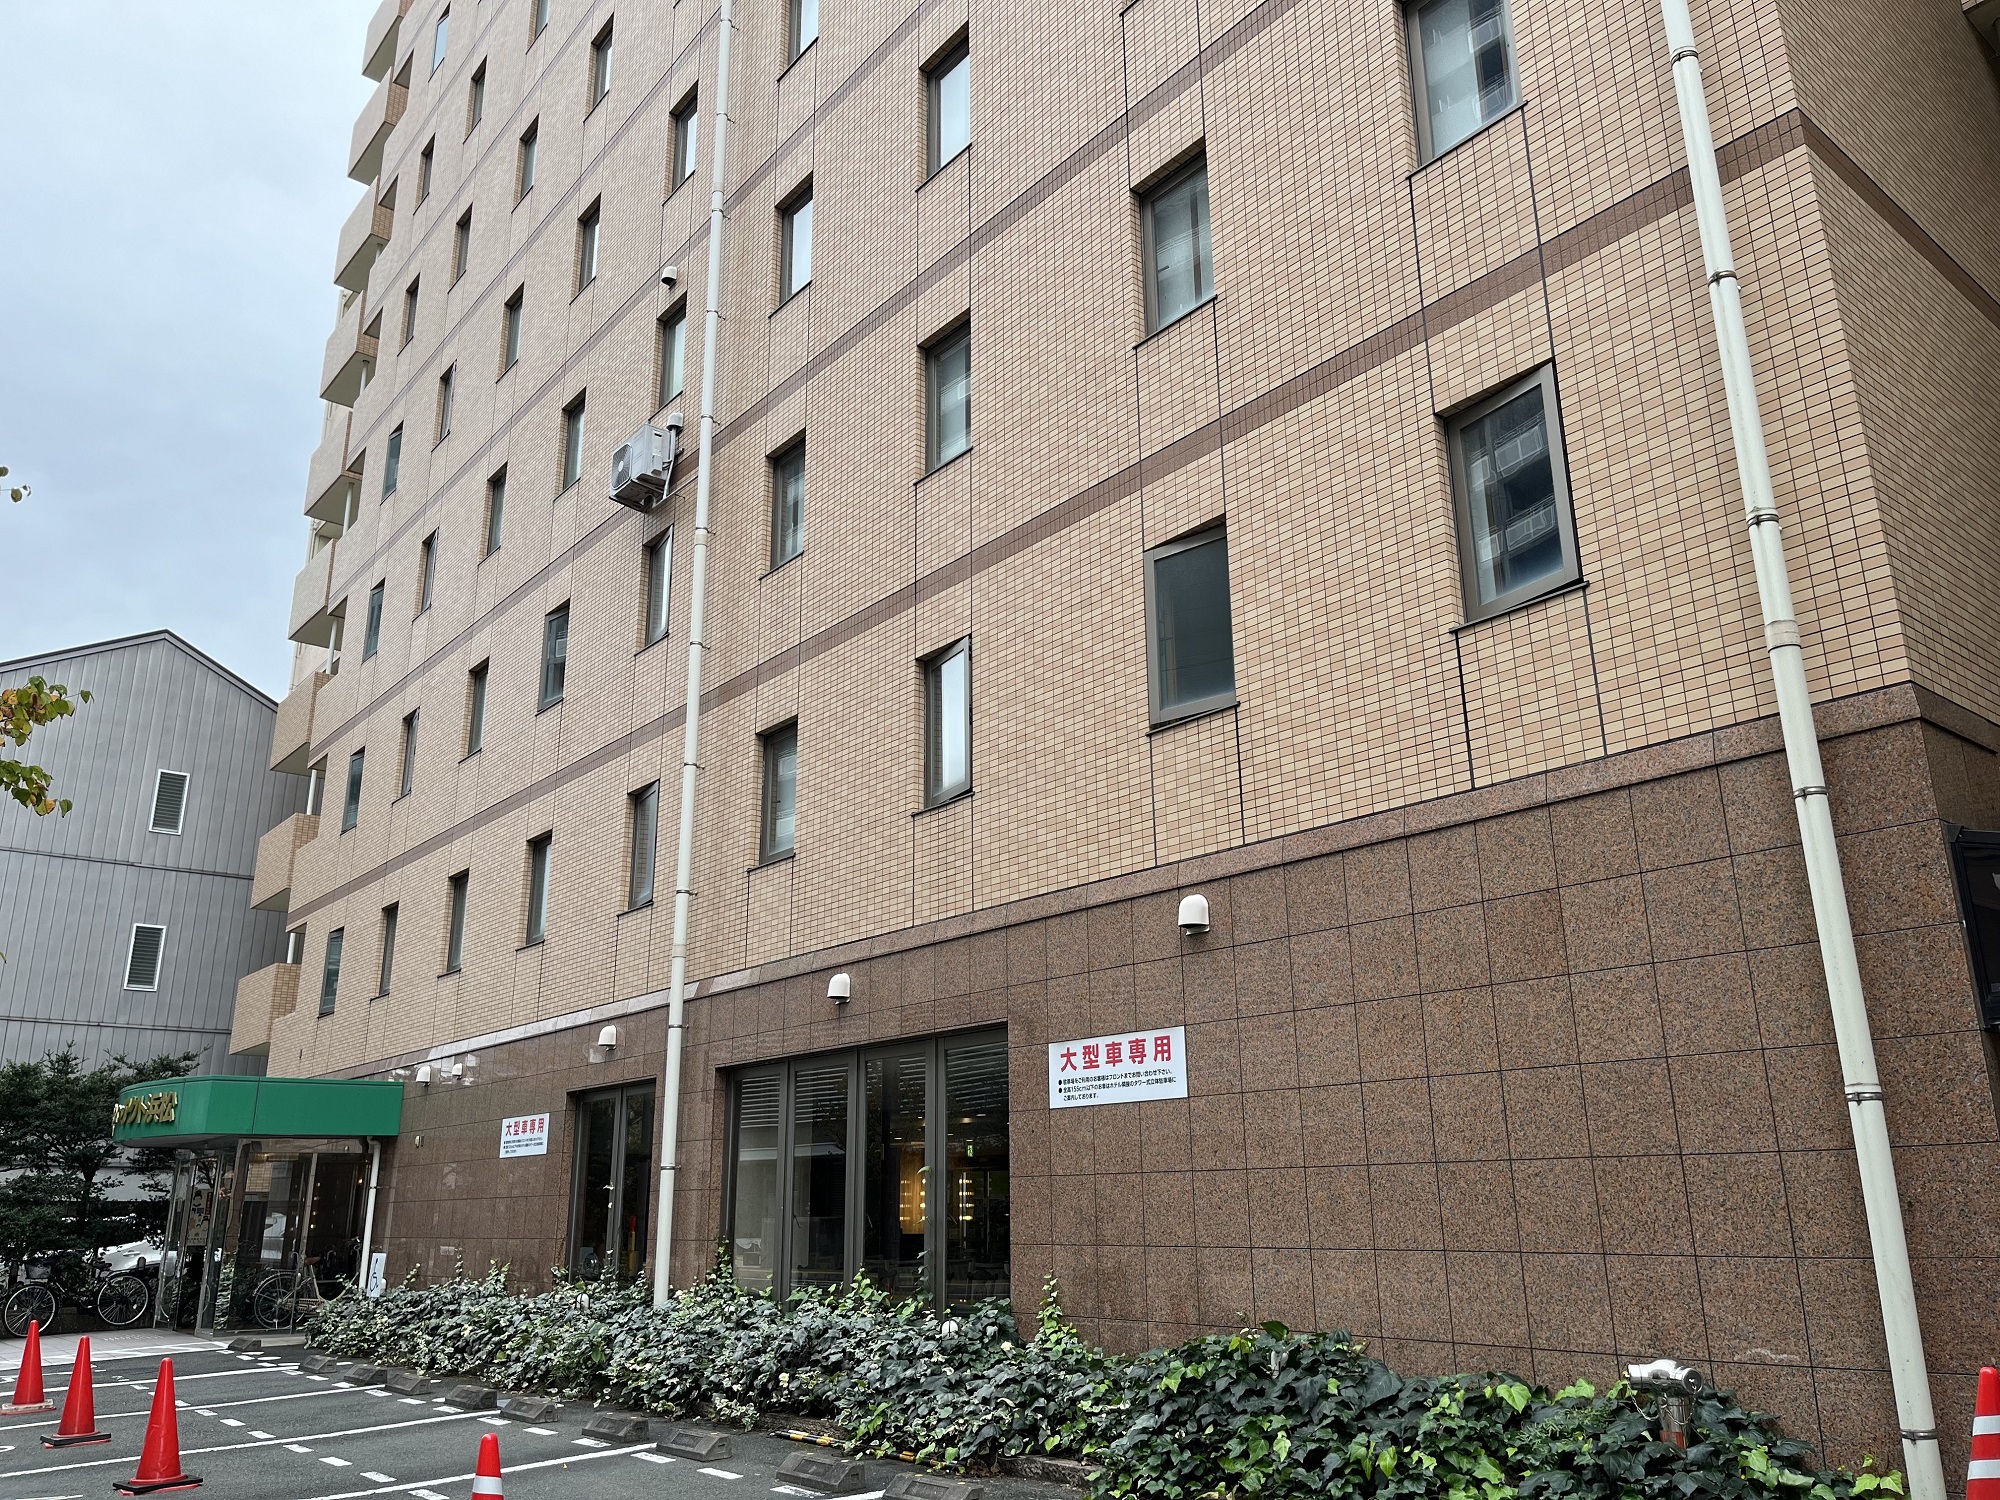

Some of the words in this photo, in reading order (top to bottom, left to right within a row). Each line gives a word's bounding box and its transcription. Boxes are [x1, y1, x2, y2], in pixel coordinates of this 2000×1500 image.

[1060, 1035, 1172, 1072] 大型車専用
[505, 1118, 545, 1136] 大型車専用
